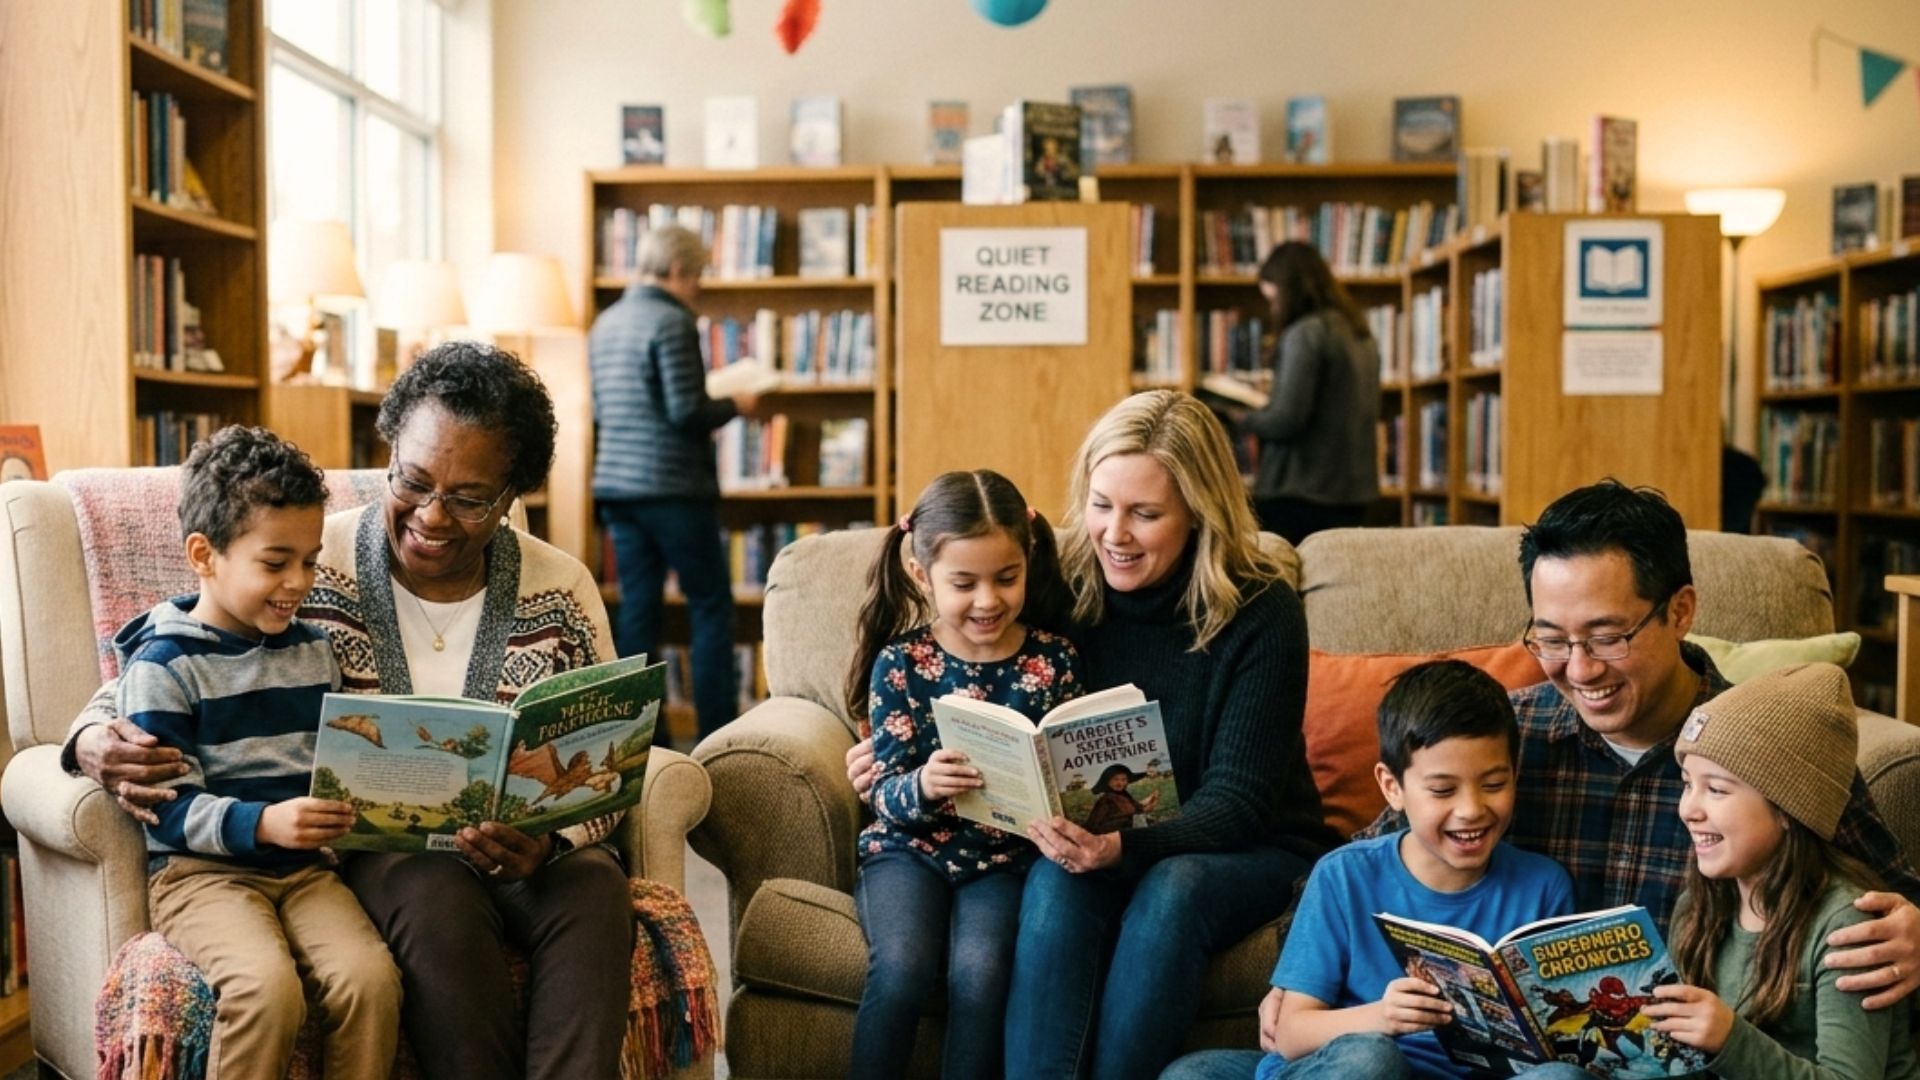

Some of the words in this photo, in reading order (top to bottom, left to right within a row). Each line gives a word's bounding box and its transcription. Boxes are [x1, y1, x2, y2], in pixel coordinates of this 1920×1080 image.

[976, 246, 1051, 268] QUIET
[956, 274, 1070, 295] READING
[979, 302, 1048, 322] ZONE
